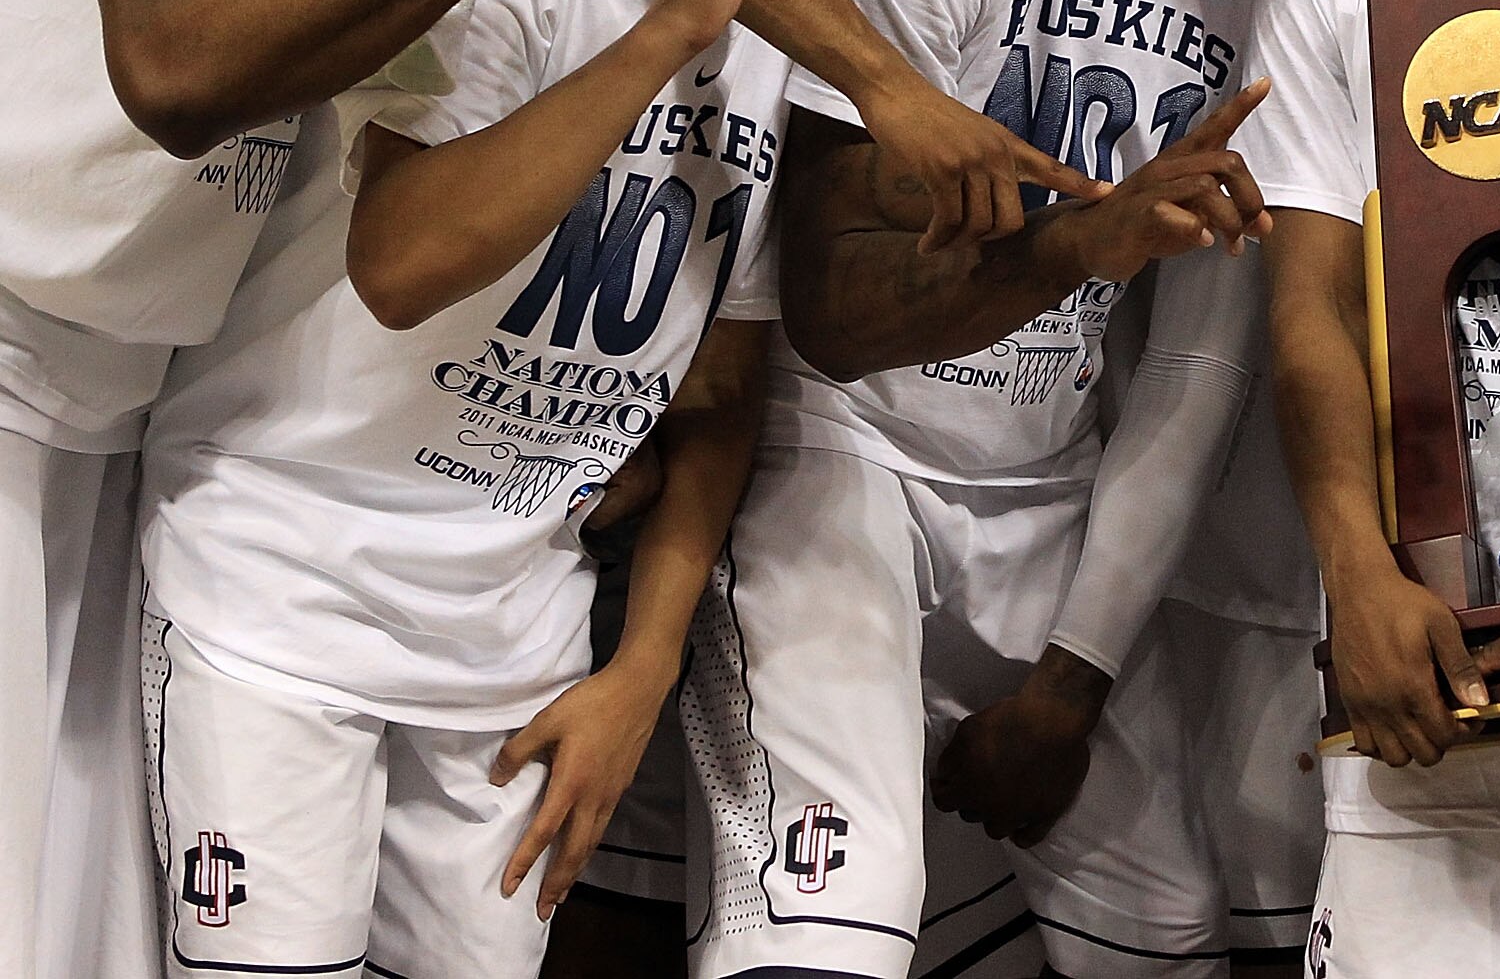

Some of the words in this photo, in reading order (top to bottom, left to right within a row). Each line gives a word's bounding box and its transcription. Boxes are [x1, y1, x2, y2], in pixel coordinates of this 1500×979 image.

[431, 360, 663, 439] CHAMPIO
[458, 406, 496, 430] 2011
[414, 446, 501, 493] UCONN
